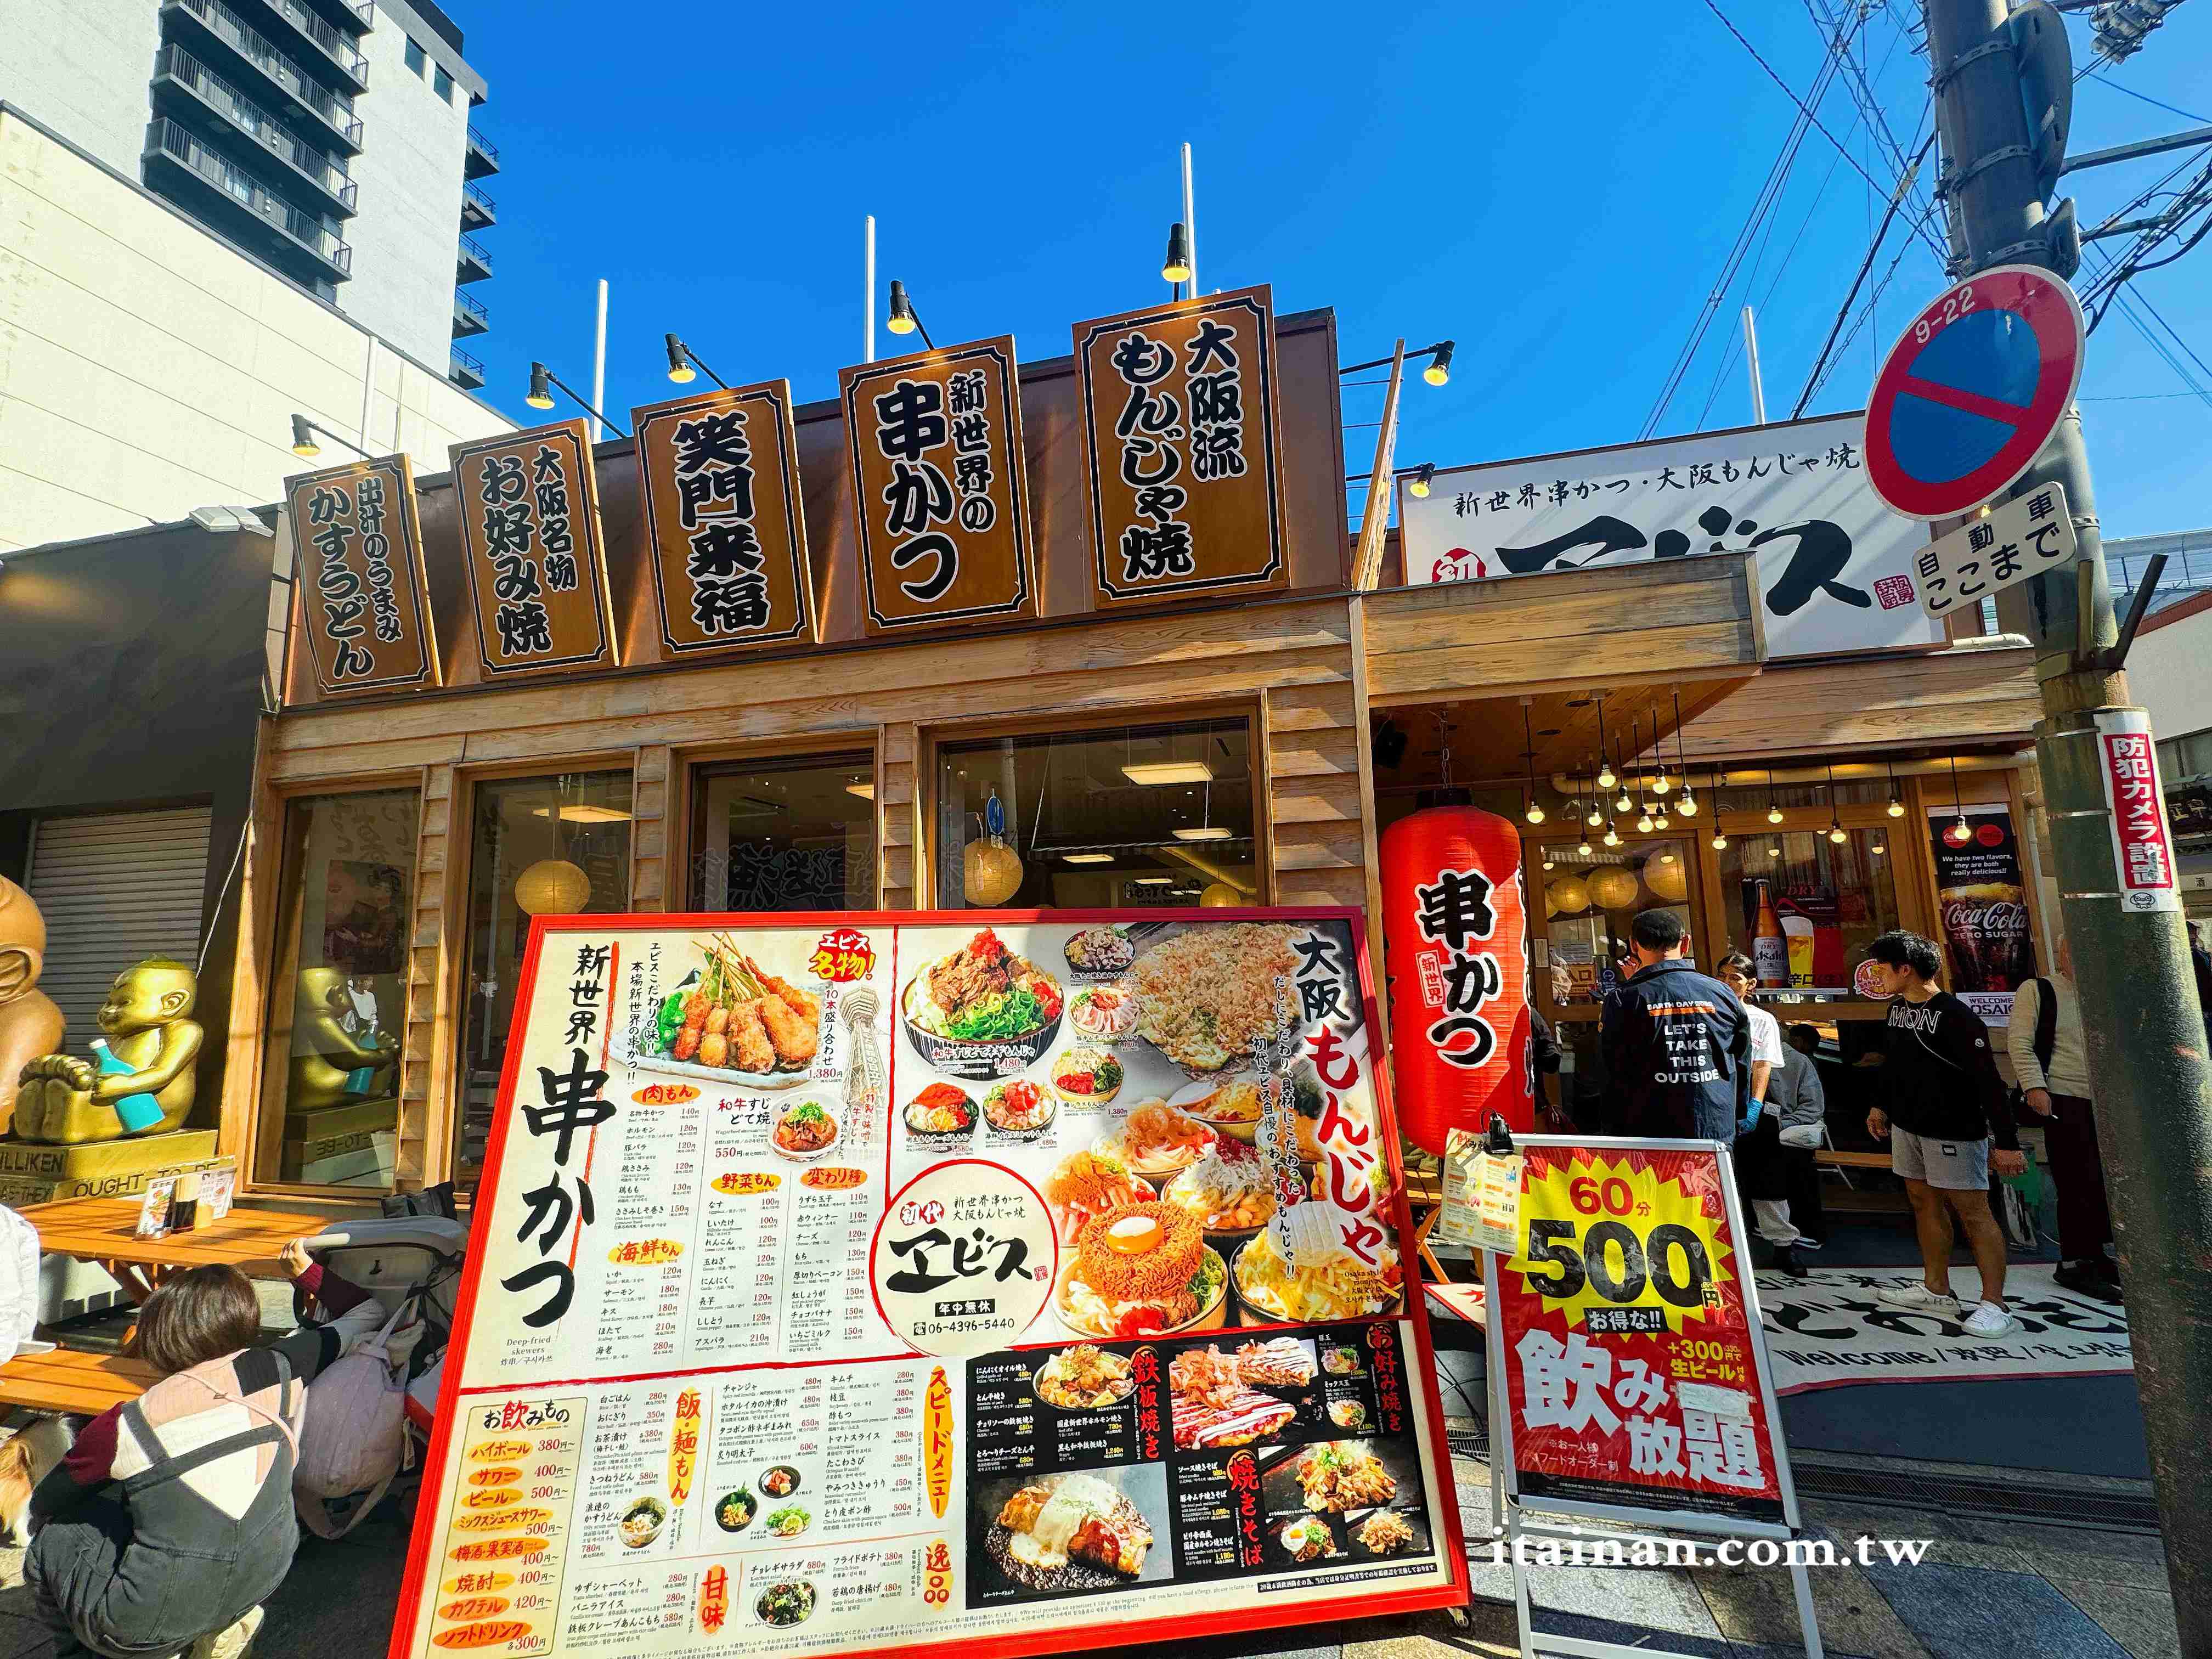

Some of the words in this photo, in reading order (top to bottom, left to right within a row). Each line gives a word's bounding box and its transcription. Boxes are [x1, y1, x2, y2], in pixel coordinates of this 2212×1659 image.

[1916, 286, 1975, 343] 9-22
[1185, 318, 1246, 481] 大阪流
[947, 369, 996, 533] 新世界の
[1113, 332, 1195, 583] もんじゃ焼
[873, 379, 958, 603] 串かつ
[532, 444, 579, 591] 大阪名物
[671, 409, 771, 637] 笑門来福
[1918, 490, 2055, 578] 自動車
[357, 476, 403, 642] 出汁のうまみ
[480, 455, 552, 657] お好み焼
[1926, 520, 2059, 611] ここまで
[308, 486, 375, 679] かすうどん
[1787, 886, 1817, 895] DRY
[1945, 902, 2028, 931] Coca-Cola
[809, 950, 877, 981] 名物!
[1414, 868, 1503, 1069] 串かつ
[1419, 956, 1443, 1002] 新世界
[564, 944, 611, 1045] 新世界
[822, 989, 838, 1066] 10本盛り合わせ
[1664, 1023, 1706, 1036] LET'S
[1666, 1039, 1707, 1051] TAKE
[1670, 1055, 1706, 1067] THIS
[808, 1068, 843, 1081] 1,380円
[1655, 1069, 1719, 1084] OUTSIDE
[642, 1084, 692, 1104] 肉もん
[717, 1097, 770, 1113] 和牛すじ
[1291, 931, 1387, 1266] 大阪もんじゃ
[715, 1147, 742, 1158] 550円
[500, 1047, 617, 1327] 串かつ
[720, 1173, 775, 1189] 野菜もん
[807, 1167, 862, 1186] 変わり種
[953, 1195, 1023, 1208] 新世界串かつ
[1570, 1176, 1651, 1217] 60分
[707, 1219, 735, 1227] しいたけ
[900, 1201, 945, 1226] 初代
[796, 1232, 818, 1241] チーズ
[616, 1238, 680, 1263] 海鮮もん
[701, 1276, 729, 1285] にんにく
[939, 1301, 991, 1316] 年中無休
[928, 1318, 1014, 1334] 06-4396-5440
[1588, 1310, 1662, 1331] お得な!!
[1772, 1350, 1937, 1365] Welcome
[830, 1374, 854, 1383] キムチ
[1370, 1321, 1403, 1431] お好み焼き
[1515, 1329, 1670, 1437] 飲み
[600, 1395, 631, 1403] 白ごはん
[1131, 1352, 1161, 1459] 鉄板焼き
[483, 1398, 571, 1431] お飲みもの
[597, 1413, 627, 1422] おにぎり
[594, 1432, 627, 1442] お茶漬け
[828, 1432, 880, 1443] トマトスライス
[929, 1369, 951, 1514] スピードメニュー
[471, 1441, 530, 1459] ハイボール
[477, 1469, 517, 1484] サワー
[589, 1472, 635, 1484] きつねうどん
[469, 1489, 509, 1508] ビール
[459, 1509, 548, 1529] ミックスジュースサワー
[1229, 1458, 1264, 1566] 焼きそば
[833, 1550, 882, 1565] フライドポテト
[455, 1571, 495, 1594] 焼酎
[449, 1598, 503, 1620] カクテル
[700, 1567, 729, 1628] 甘味
[441, 1623, 524, 1646] ソフトドリンク
